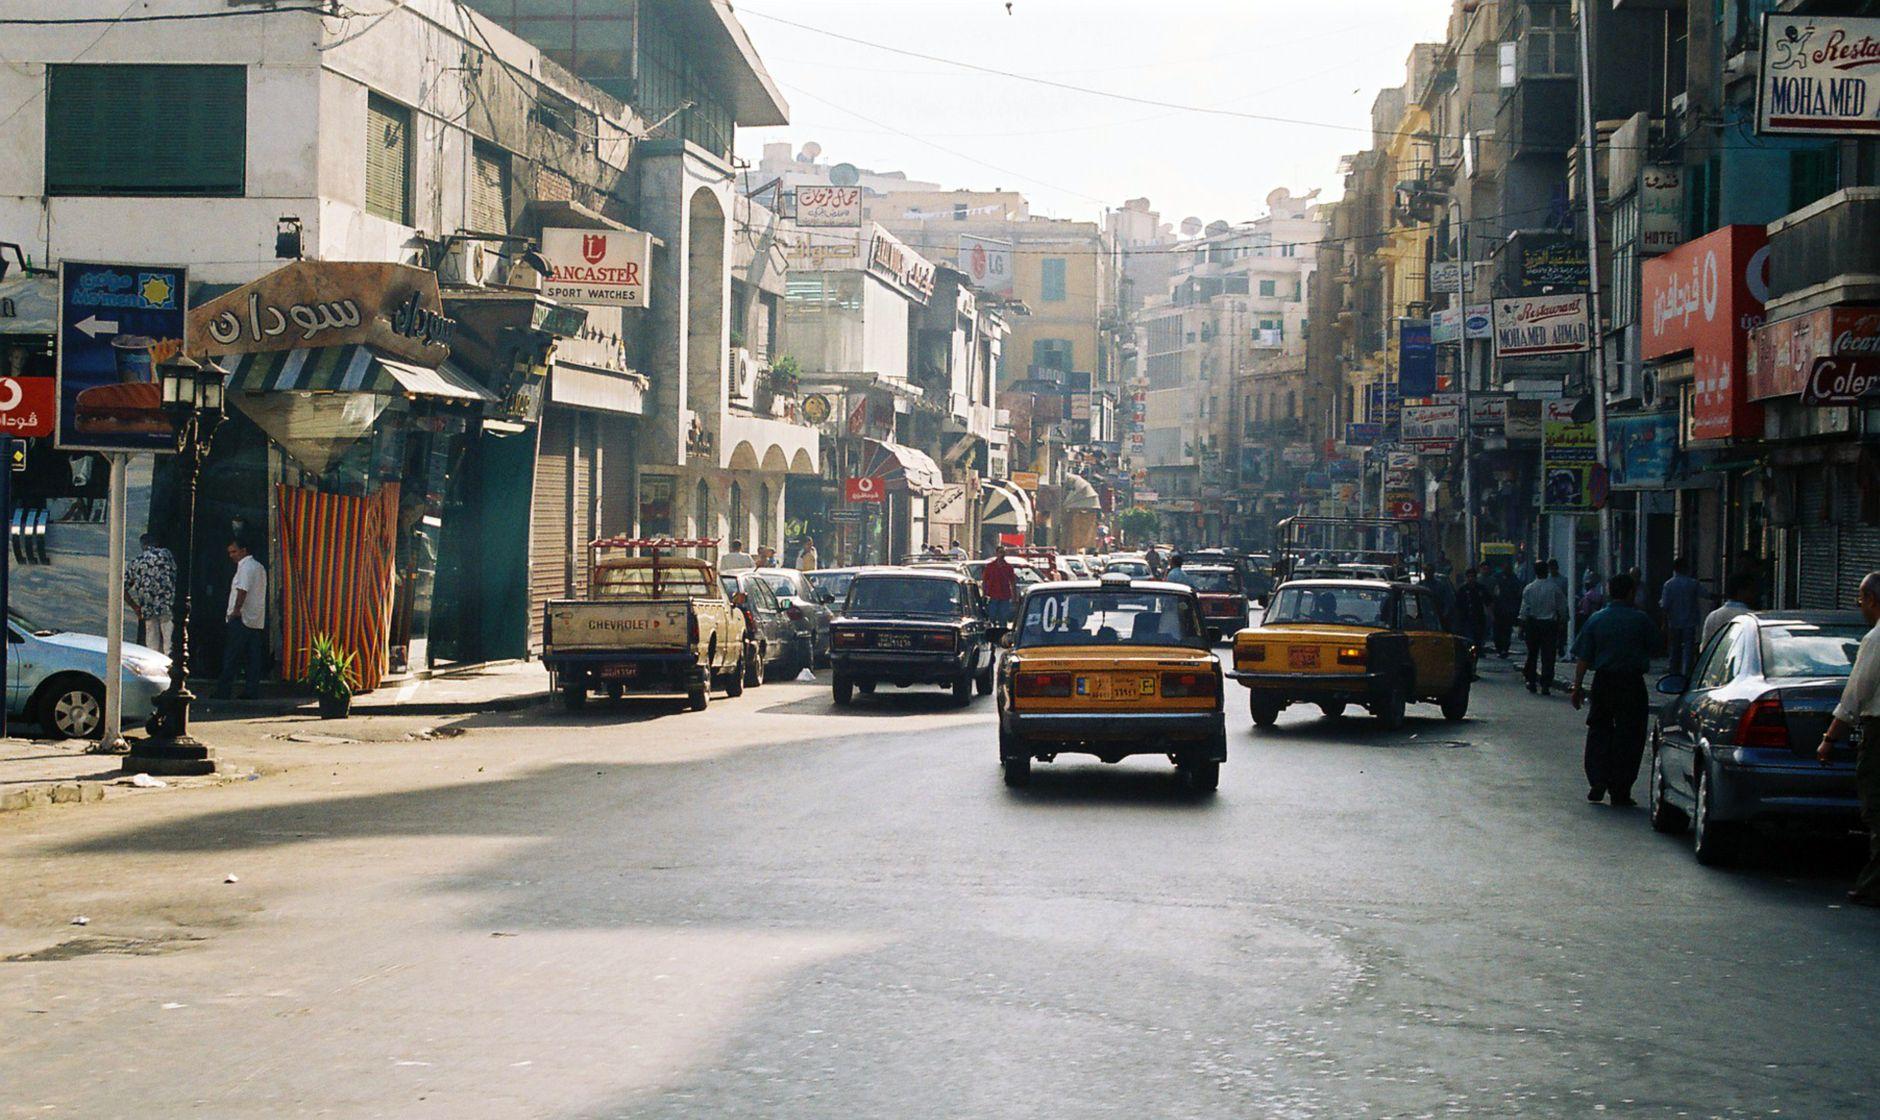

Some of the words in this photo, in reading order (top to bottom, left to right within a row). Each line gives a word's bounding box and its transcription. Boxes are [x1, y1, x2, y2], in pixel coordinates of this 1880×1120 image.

[1771, 76, 1866, 117] MOHAMED
[1644, 231, 1679, 245] HOTEL
[989, 253, 1004, 275] LG
[548, 288, 582, 299] SPORT
[588, 289, 636, 301] WATCHES
[209, 293, 361, 344] سودان
[1517, 299, 1581, 321] Restaurant
[1499, 326, 1547, 348] MOHAMED
[1552, 323, 1586, 344] AHMAD
[588, 619, 649, 632] CHEVROLET
[1043, 596, 1070, 633] 01
